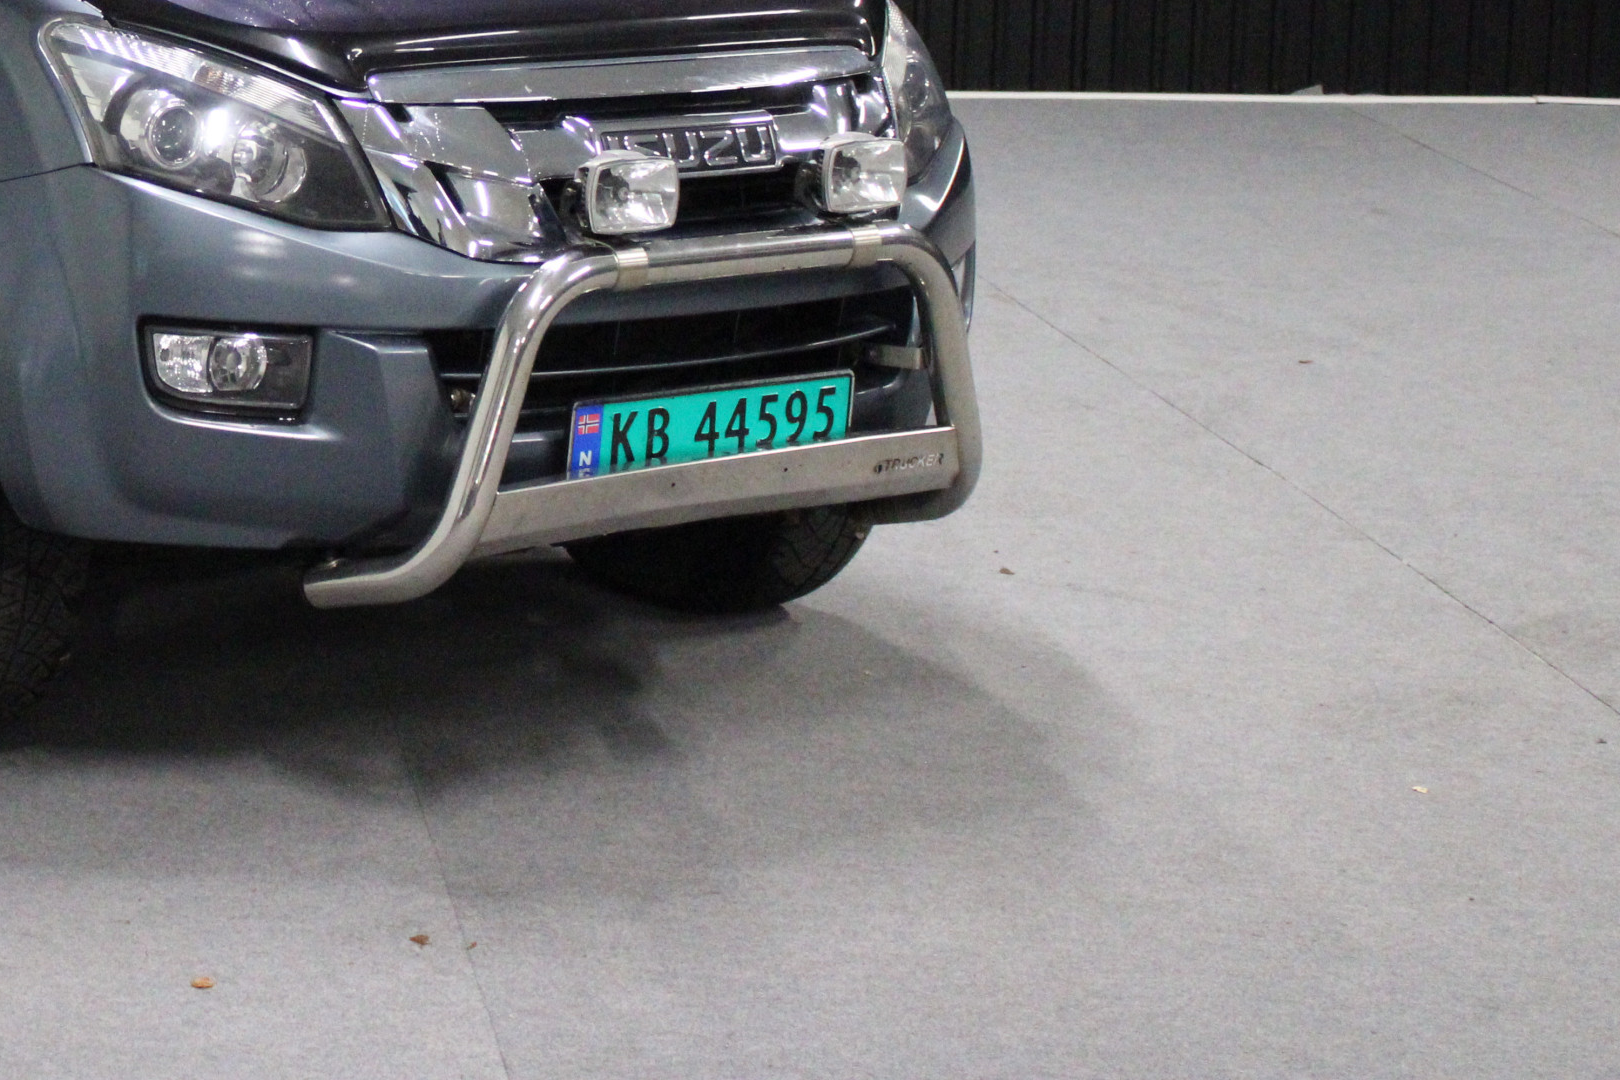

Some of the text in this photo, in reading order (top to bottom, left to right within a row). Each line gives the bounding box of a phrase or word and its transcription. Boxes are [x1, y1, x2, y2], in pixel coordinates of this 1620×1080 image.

[610, 385, 837, 465] KB 44595
[579, 450, 592, 466] N
